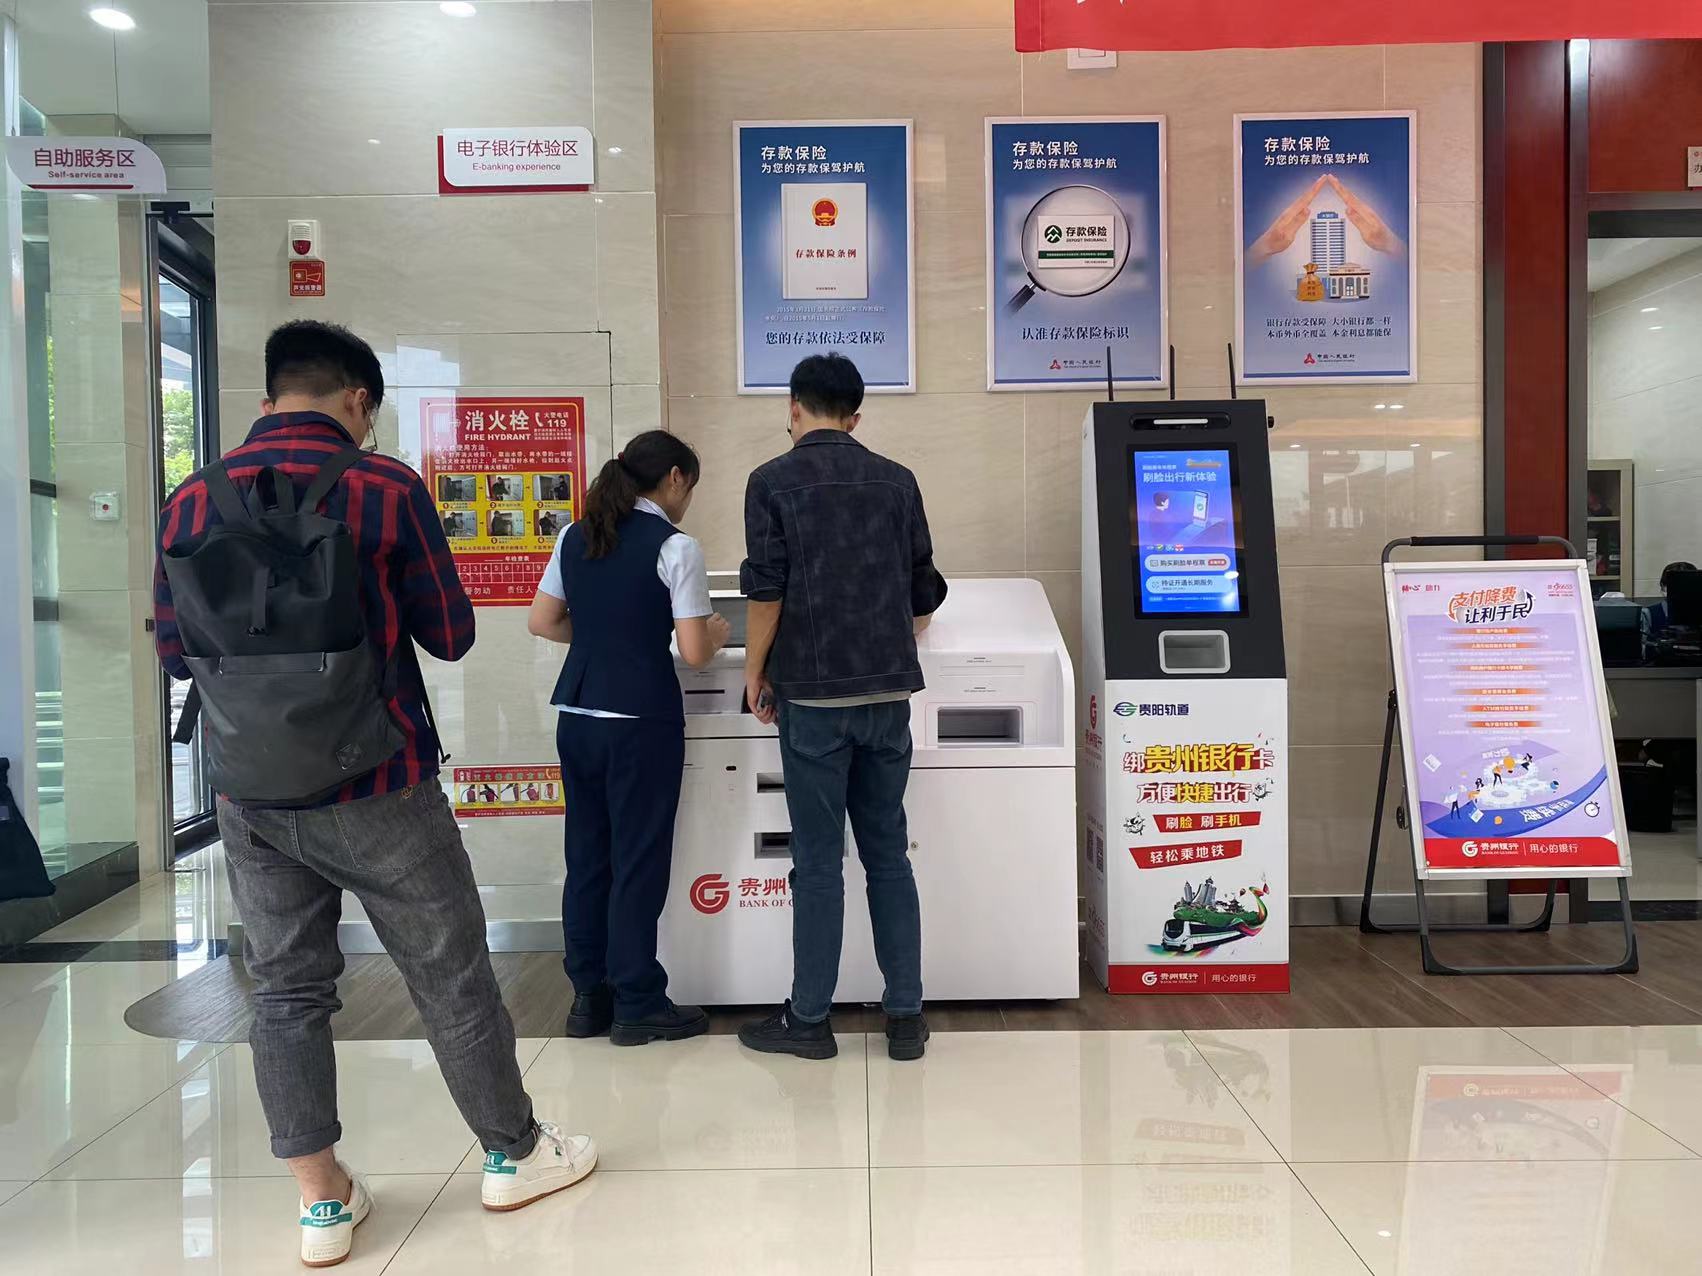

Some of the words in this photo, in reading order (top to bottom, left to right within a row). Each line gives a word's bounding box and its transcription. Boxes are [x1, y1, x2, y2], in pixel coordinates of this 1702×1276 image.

[457, 139, 578, 157] 电子银行体验区
[1012, 141, 1078, 157] 存款保险
[1264, 136, 1330, 152] 存款保险
[34, 147, 136, 168] 自助服务区
[761, 145, 827, 161] 存款保险
[1264, 152, 1369, 166] 为您的存款保驾护航
[472, 163, 514, 172] E-banking
[516, 163, 561, 171] experience
[761, 161, 865, 174] 为您的存款保驾护航
[1012, 157, 1117, 170] 为您的存款保驾护航
[48, 171, 102, 179] Self-service
[1066, 226, 1107, 237] 存款保险
[796, 249, 857, 259] 存款保险条例
[1266, 318, 1326, 327] 银行存款受保障
[1331, 316, 1391, 326] 大小银行都一样
[766, 331, 886, 345] 您的存款依法受保障
[1022, 326, 1129, 340] 认准存款保险标识
[1267, 329, 1327, 338] 本币外币全覆盖
[1332, 328, 1392, 337] 本金利息都能保
[465, 410, 529, 431] 消火栓
[548, 419, 567, 428] 119
[487, 433, 531, 441] HYDRANT
[1143, 472, 1217, 483] 刷脸出行新体验
[1453, 586, 1518, 608] 支付降费
[1464, 602, 1529, 624] 让利于民
[1139, 704, 1190, 716] 贵阳轨道
[1123, 743, 1275, 774] 绑贵州银行卡
[1137, 782, 1253, 804] 方便快捷出行
[1165, 816, 1193, 829] 刷脸
[1200, 814, 1242, 828] 刷手机
[1150, 844, 1225, 864] 轻松乘地铁
[1480, 843, 1519, 851] 贵州银行
[1530, 844, 1578, 854] 用心的银行
[739, 899, 769, 908] BANK
[772, 899, 785, 907] OF
[1211, 974, 1257, 983] 用心的银行
